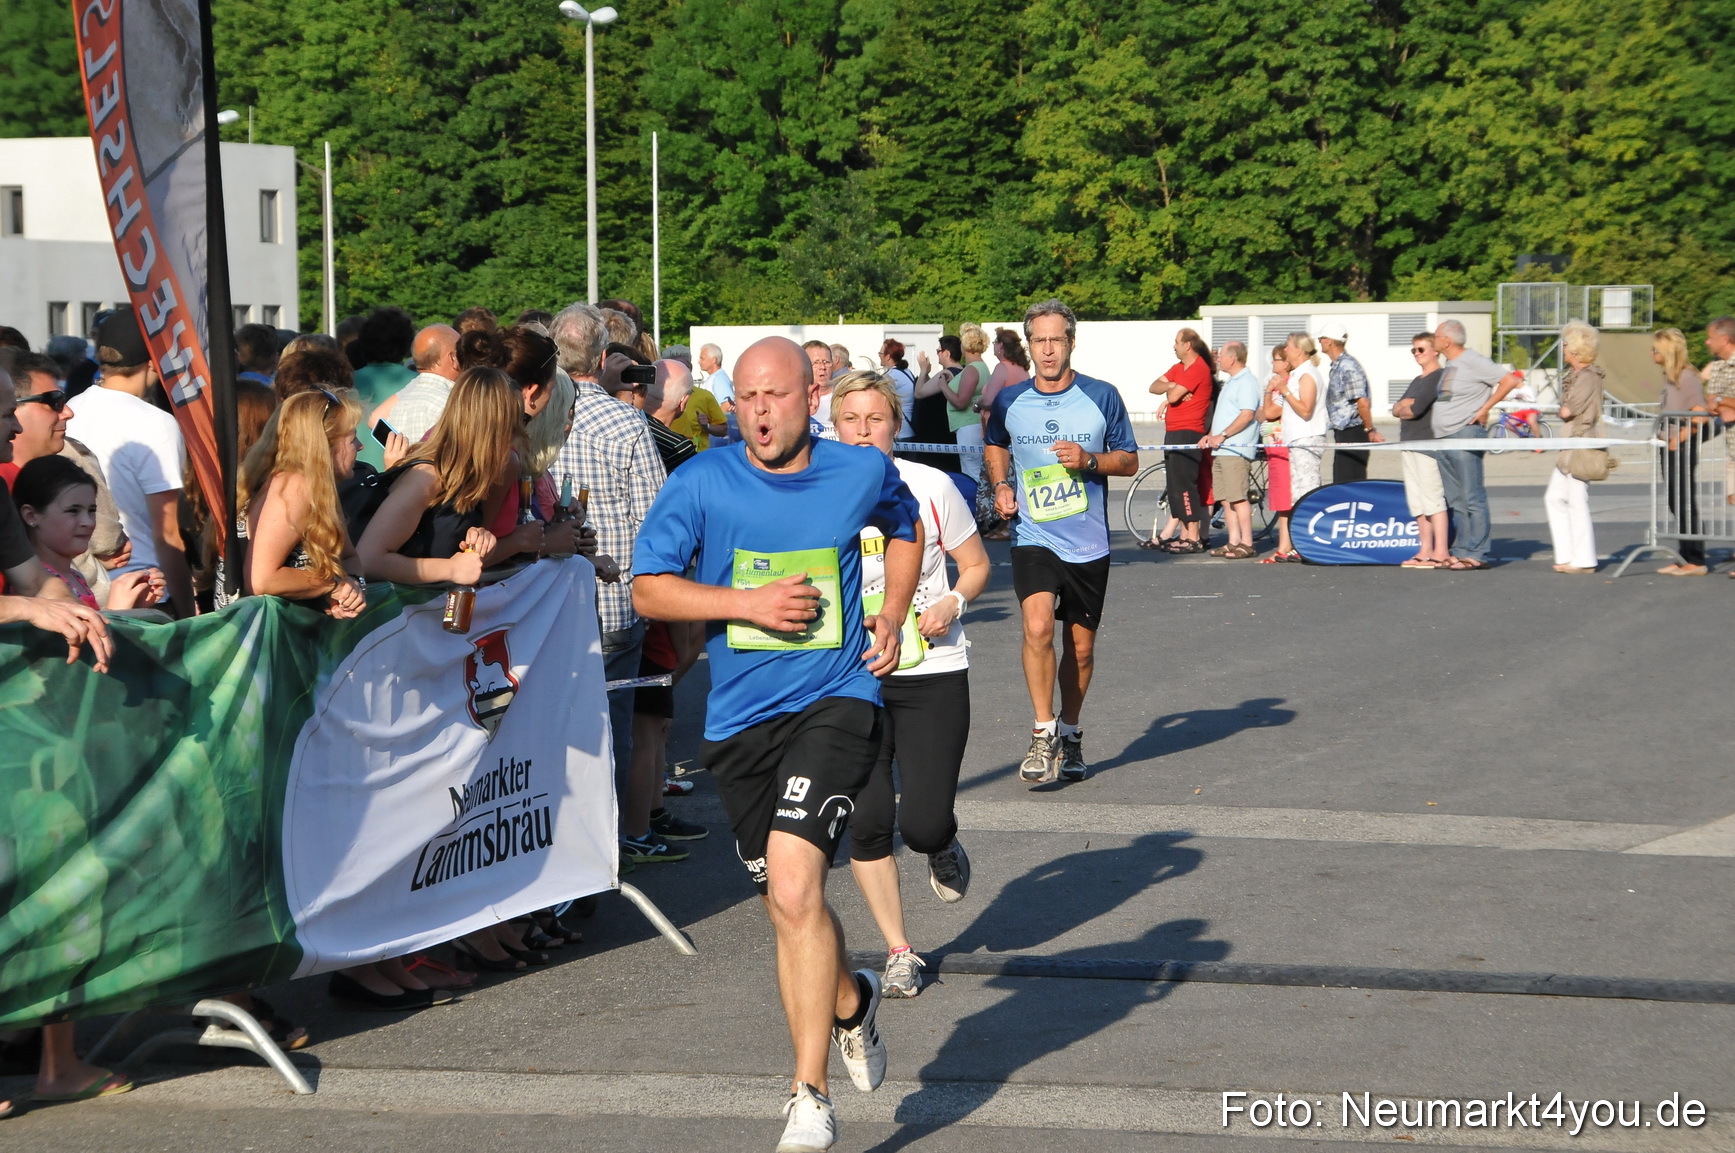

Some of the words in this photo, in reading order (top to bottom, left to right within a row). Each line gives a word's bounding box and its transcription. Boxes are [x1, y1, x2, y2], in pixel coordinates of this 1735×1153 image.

[1016, 433, 1091, 445] SCHABMÜLLER
[1029, 478, 1082, 508] 1244
[1331, 517, 1420, 539] Fische
[1340, 539, 1421, 549] AUTOMOBIL
[449, 756, 532, 825] Neumarkter
[783, 776, 811, 802] 19
[777, 808, 800, 820] JAKO
[411, 797, 553, 891] Lammsbräu
